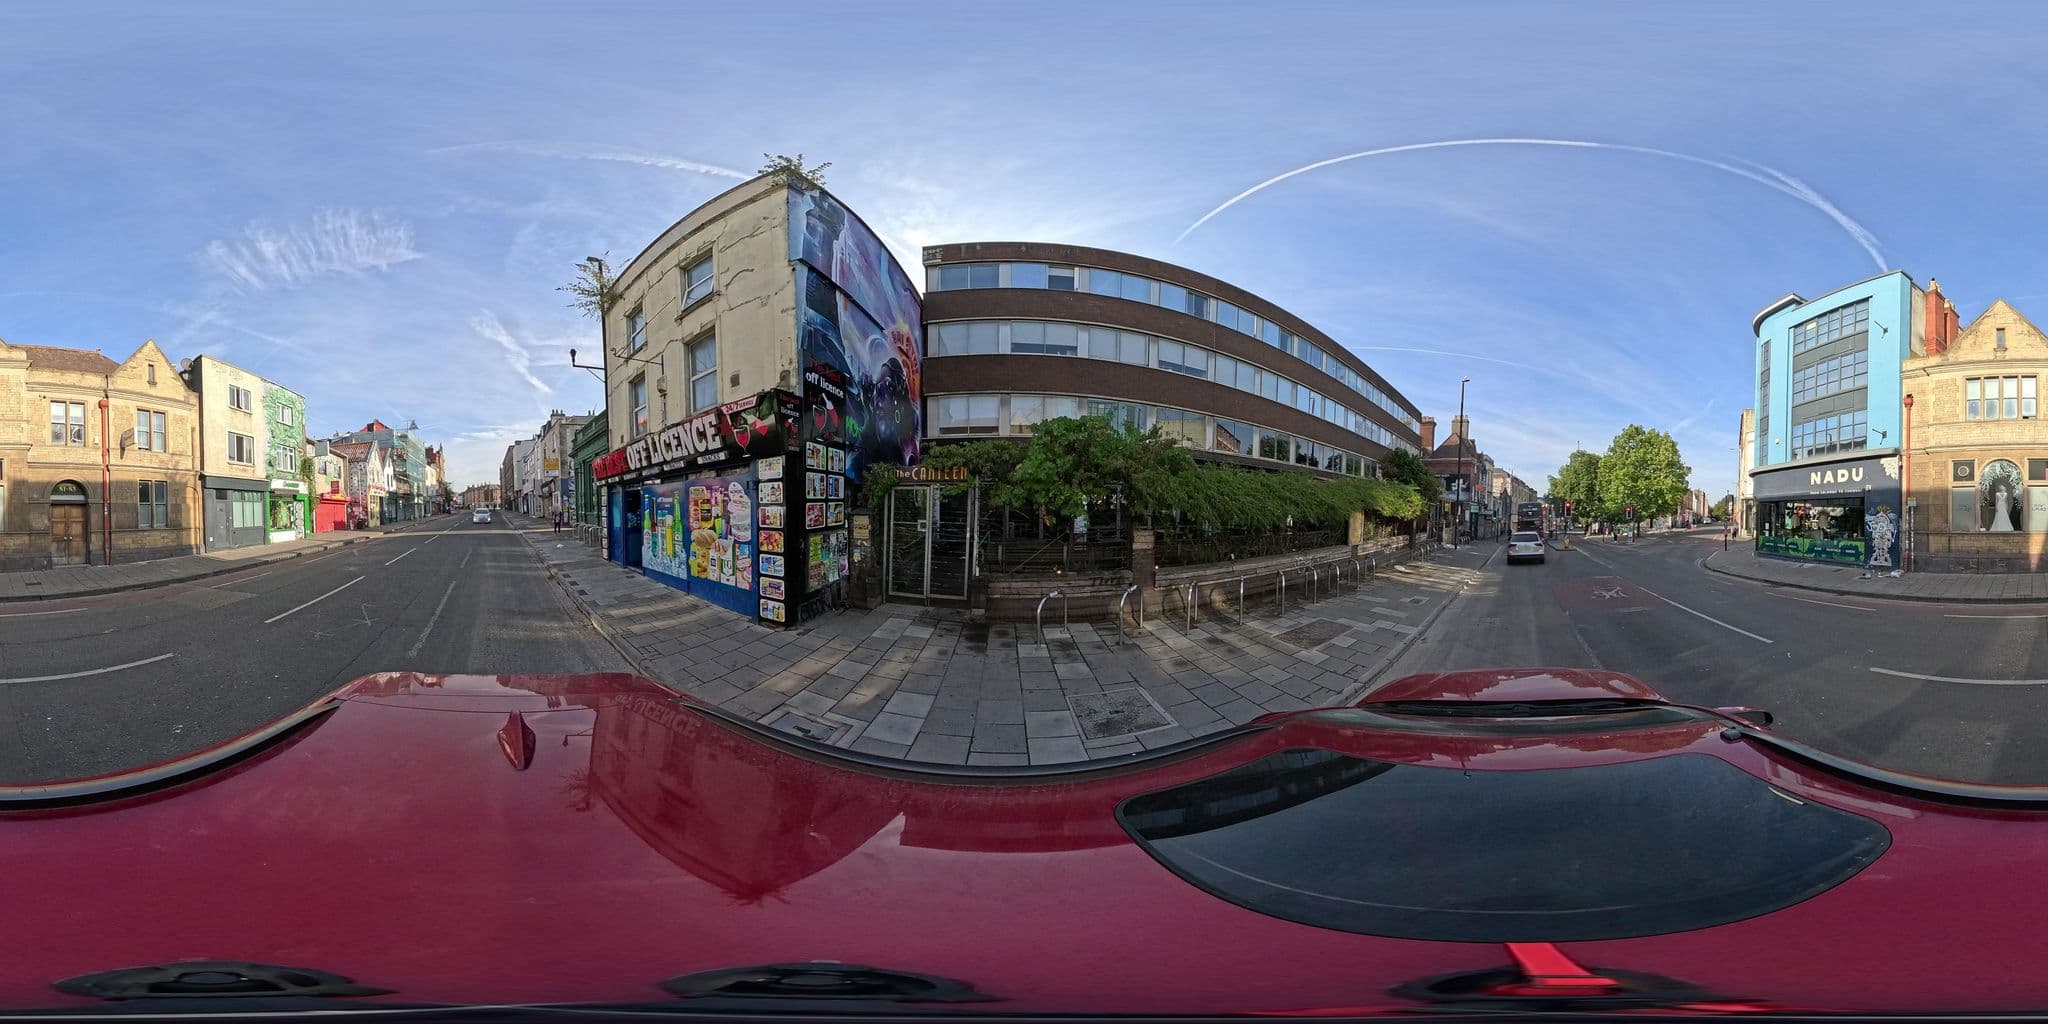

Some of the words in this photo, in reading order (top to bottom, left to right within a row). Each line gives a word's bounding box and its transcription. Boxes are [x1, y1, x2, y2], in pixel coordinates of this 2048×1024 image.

[805, 372, 820, 386] off
[820, 376, 844, 399] licence
[626, 440, 649, 470] OFF
[646, 413, 722, 465] LICENCE
[896, 470, 910, 478] The
[911, 466, 969, 480] CANTEEN
[1810, 467, 1864, 485] NADU
